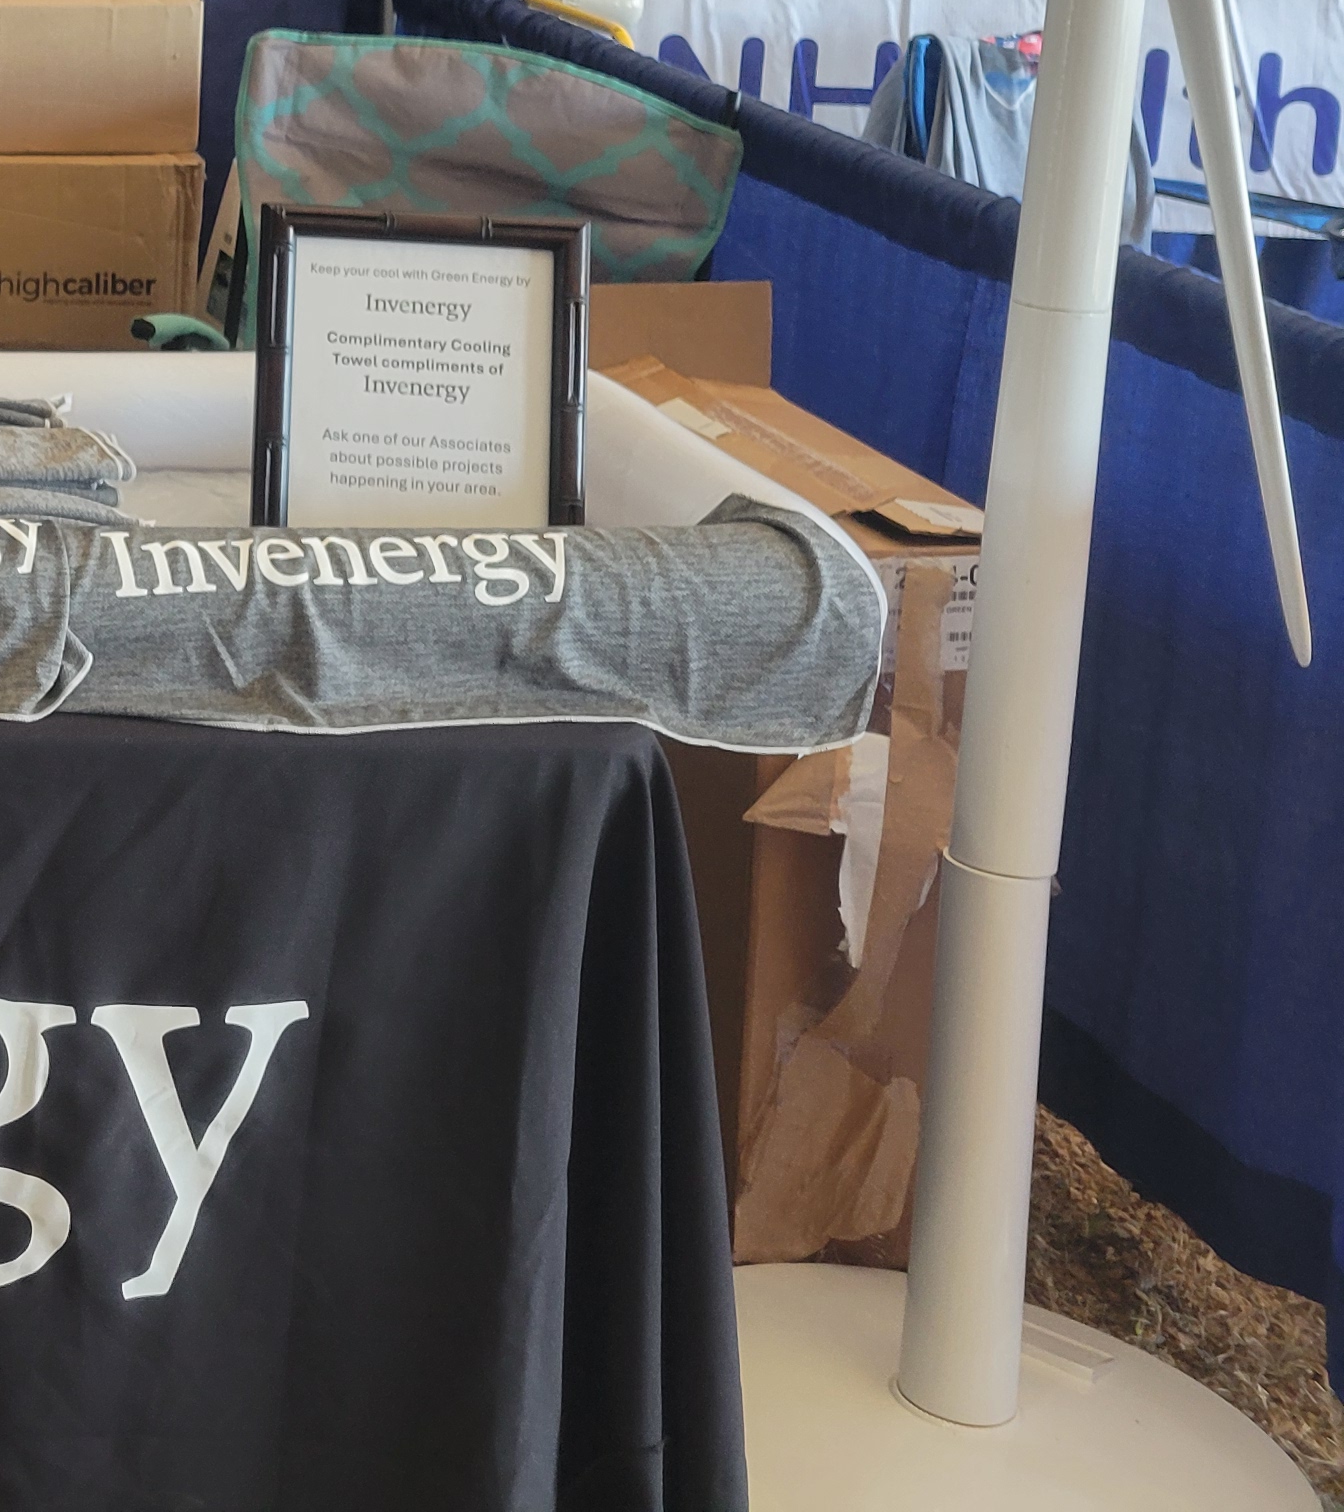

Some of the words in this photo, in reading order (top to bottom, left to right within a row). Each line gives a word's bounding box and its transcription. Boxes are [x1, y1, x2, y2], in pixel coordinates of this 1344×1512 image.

[310, 262, 341, 278] Keep
[343, 266, 370, 279] your
[373, 266, 400, 279] cool
[402, 267, 429, 281] with
[431, 269, 470, 284] Green
[471, 272, 514, 288] Energy
[516, 275, 531, 288] by
[365, 293, 472, 322] Invenergy
[326, 331, 447, 353] Complimentary
[450, 338, 512, 357] Cooling
[332, 353, 378, 369] Towel
[381, 356, 485, 376] compliments
[488, 362, 505, 376] of
[363, 374, 471, 404] Invenergy
[321, 427, 349, 443] Ask
[352, 432, 381, 445] one
[383, 431, 399, 445] of
[401, 436, 427, 448] our
[429, 436, 512, 454] Associates
[329, 451, 373, 467] about
[375, 454, 439, 472] possible
[442, 458, 503, 476] projects
[329, 471, 408, 492] happening
[411, 476, 424, 490] in
[427, 480, 461, 495] your
[463, 482, 502, 497] area.
[100, 530, 569, 607] Invenergy
